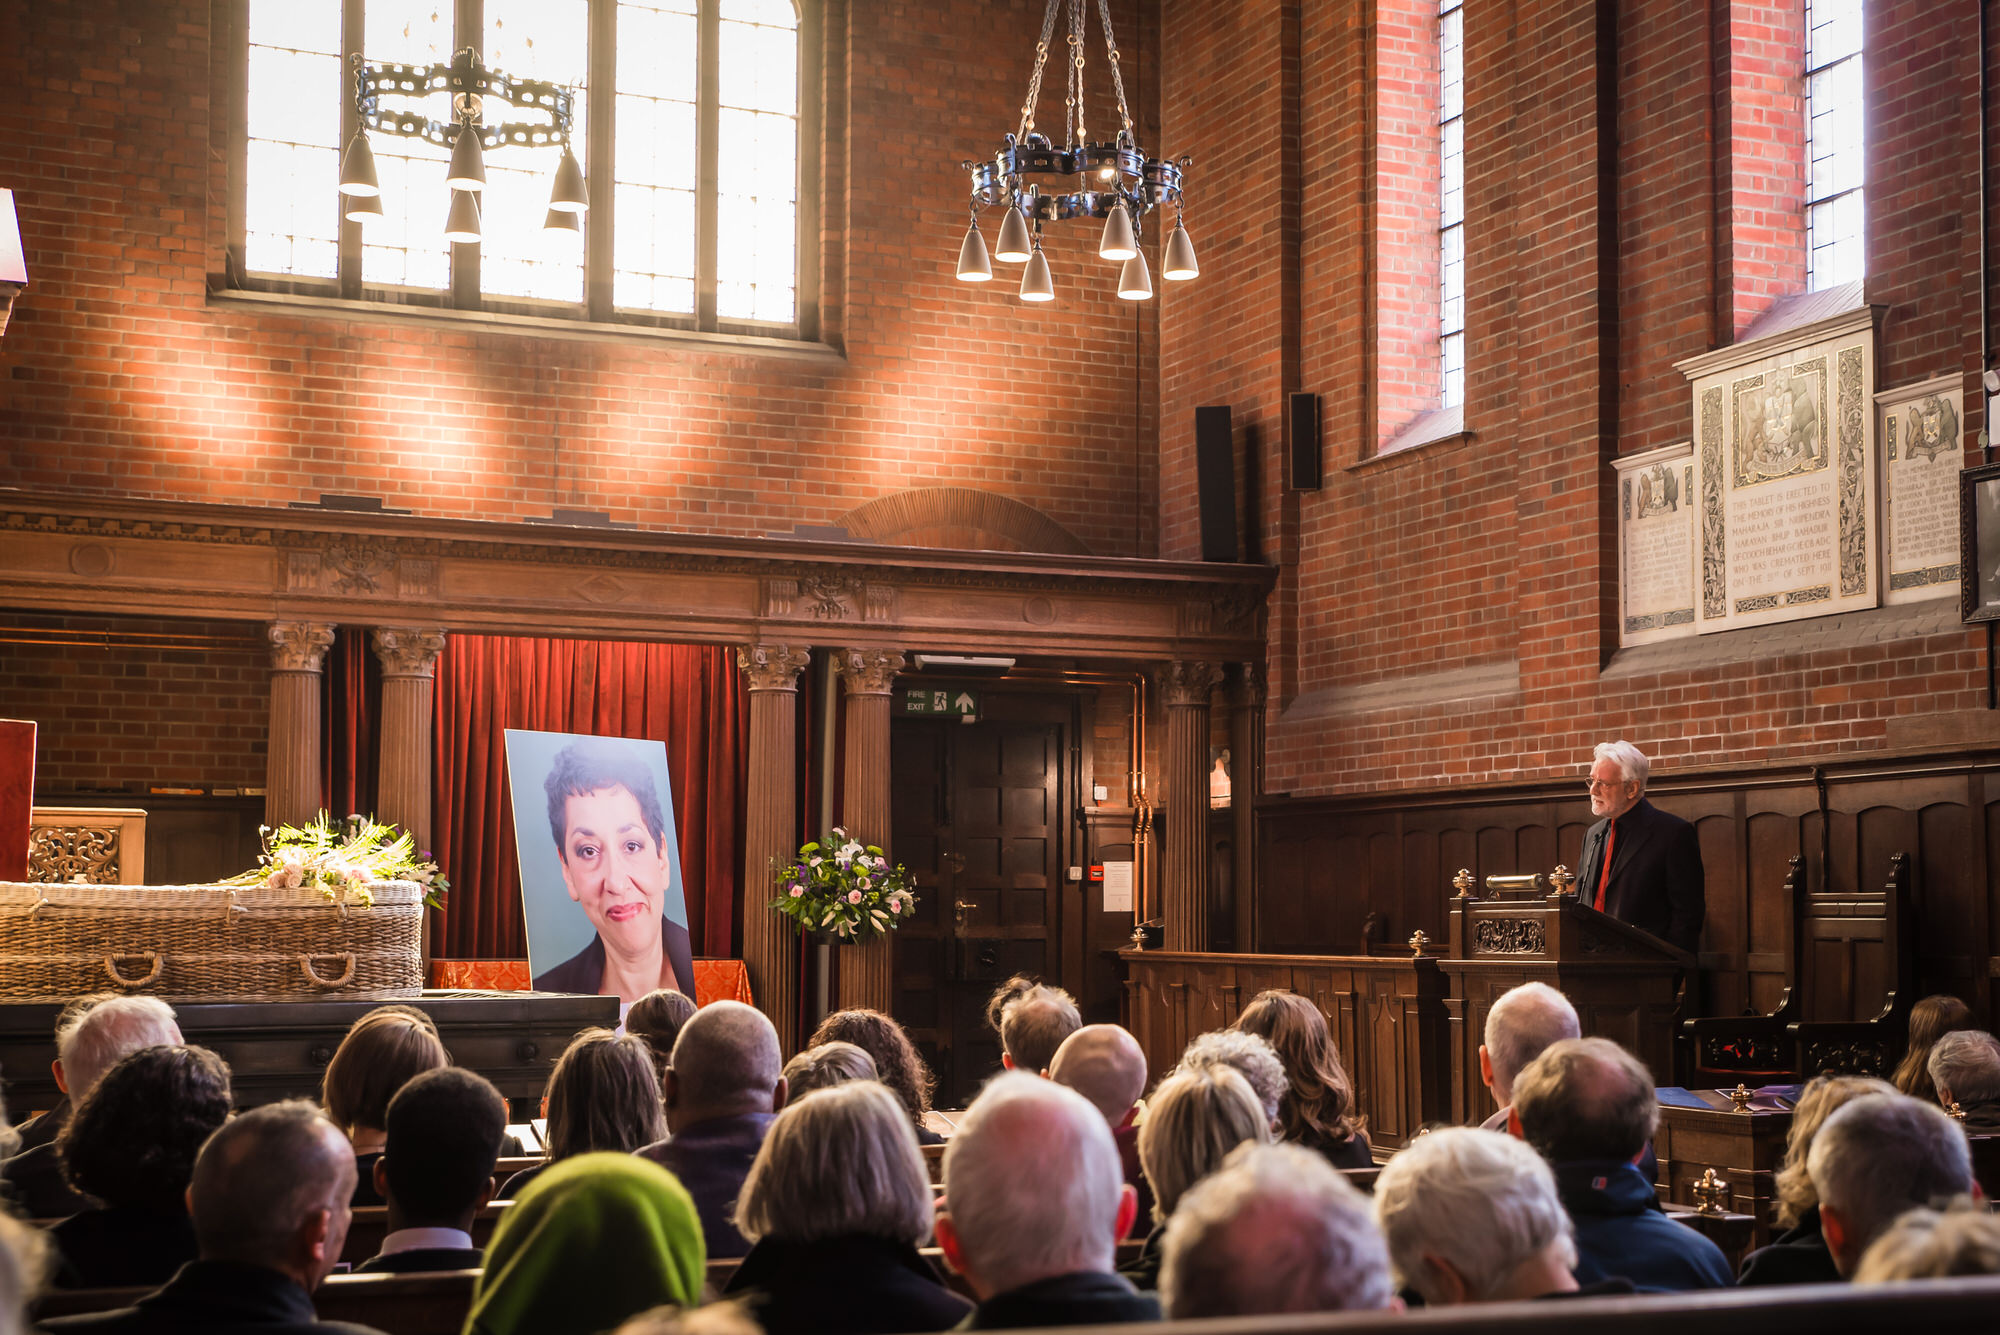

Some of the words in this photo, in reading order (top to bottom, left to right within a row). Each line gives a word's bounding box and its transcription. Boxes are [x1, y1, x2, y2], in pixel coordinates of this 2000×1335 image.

[1732, 502, 1747, 512] THIS
[1750, 494, 1774, 508] TABLET
[1786, 486, 1817, 500] ERECTED
[1820, 484, 1830, 492] TO
[1733, 514, 1746, 524] THE
[1748, 508, 1774, 520] MEMORY
[1776, 506, 1784, 514] OF
[1786, 503, 1797, 512] HIS
[1798, 496, 1831, 510] HIGHNESS
[1732, 522, 1770, 536] MAHARAJA
[1735, 536, 1768, 548] NARAYAN
[1733, 564, 1748, 574] WHO
[1752, 561, 1768, 571] WAS
[1770, 553, 1810, 568] CREMATED
[1812, 549, 1832, 560] HERE
[1749, 574, 1763, 584] THE
[1784, 570, 1792, 578] OF
[1797, 565, 1815, 576] SEPT
[908, 690, 926, 698] FIRE
[908, 702, 925, 710] EXIT
